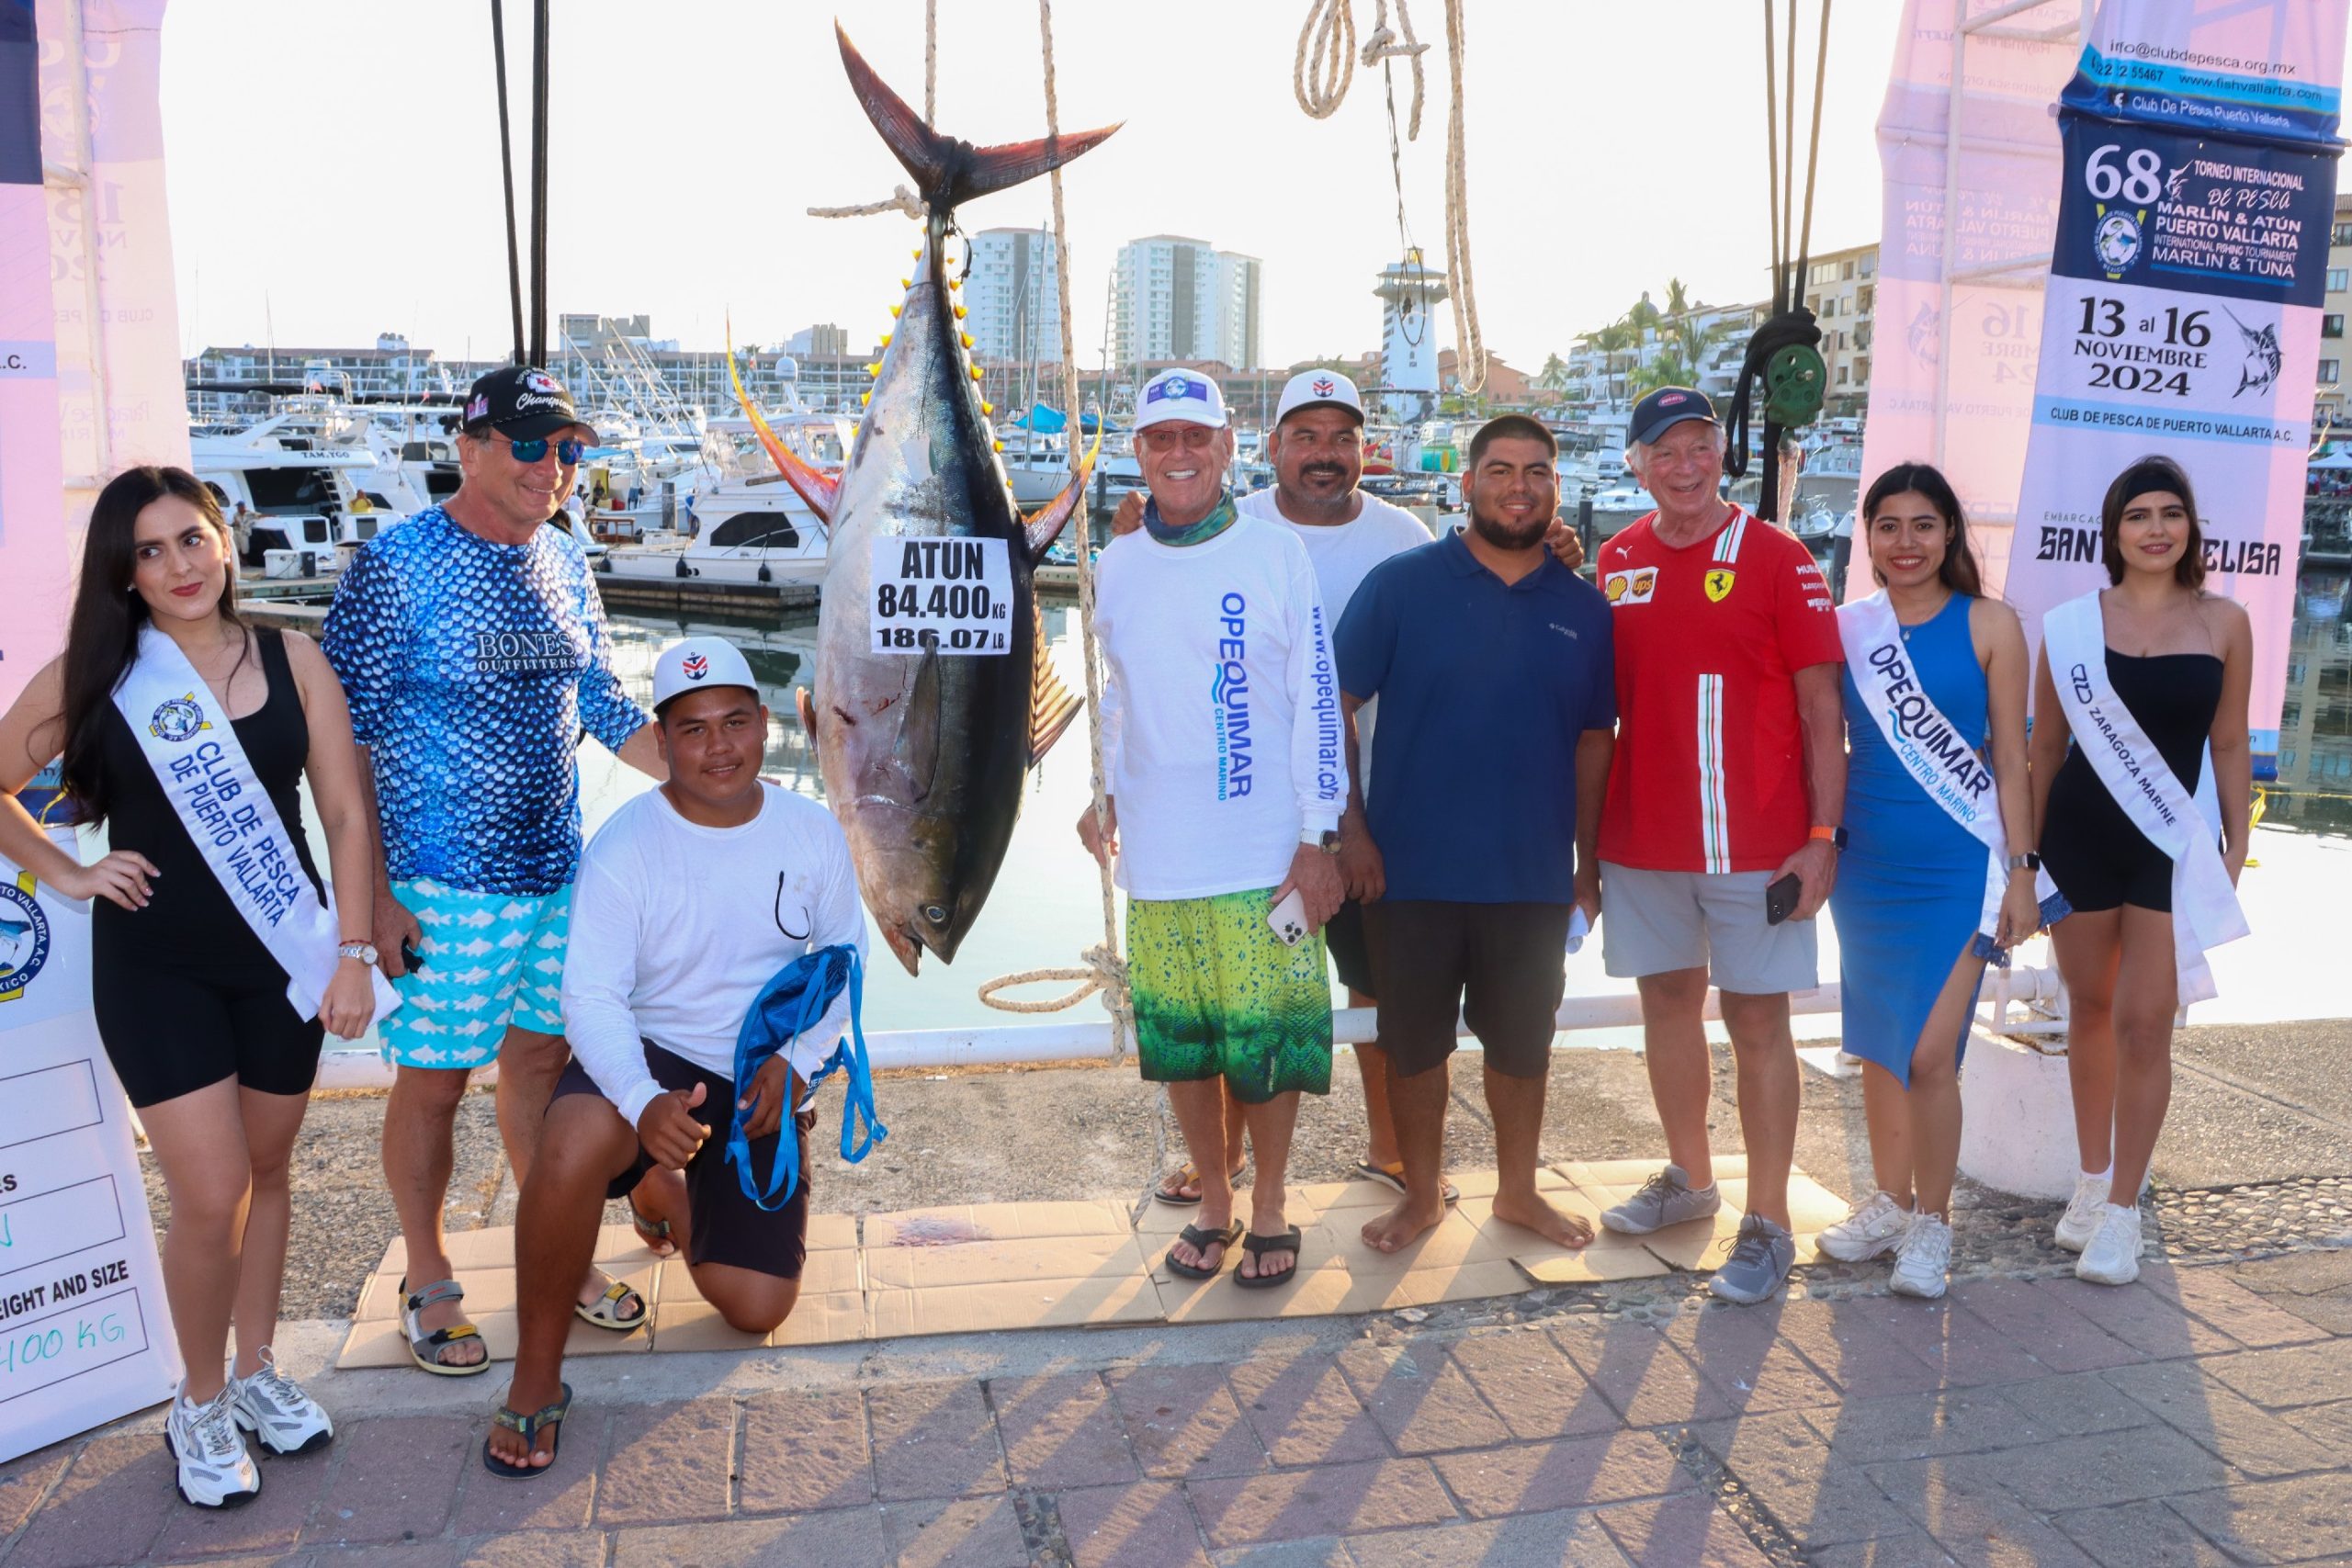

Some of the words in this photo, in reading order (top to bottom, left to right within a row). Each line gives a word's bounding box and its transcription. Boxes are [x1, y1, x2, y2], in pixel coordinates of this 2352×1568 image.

[2131, 66, 2165, 82] 55467
[2178, 72, 2323, 102] www.fishvallarta.com
[2132, 96, 2158, 113] Club
[2160, 99, 2178, 115] De
[2214, 106, 2250, 124] Puerto
[2250, 109, 2290, 129] Vallarta
[2086, 144, 2162, 205] 68
[2194, 160, 2232, 181] TORNEO
[2233, 166, 2305, 191] INTERNACIONAL
[2156, 200, 2231, 224] MARLÍN
[2234, 212, 2249, 225] &
[2252, 215, 2303, 233] ATÚN
[2207, 187, 2232, 209] DE
[2235, 189, 2291, 211] PESCA
[2154, 234, 2215, 253] INTERNATIONAL
[2215, 242, 2245, 256] FISHING
[2245, 245, 2297, 264] TOURNAMENT
[2155, 215, 2219, 239] PUERTO
[2222, 224, 2300, 250] VALLARTA
[2152, 247, 2224, 269] MARLIN
[2228, 256, 2241, 271] &
[2246, 258, 2296, 278] TUNA
[2077, 296, 2126, 338] 13
[2139, 317, 2155, 333] al
[2163, 307, 2211, 348] 16
[2074, 338, 2208, 369] NOVIEMBRE
[2087, 363, 2191, 397] 2024
[2051, 406, 2078, 422] CLUB
[2083, 411, 2099, 423] DE
[2102, 412, 2143, 429] PESCA
[2145, 416, 2160, 430] DE
[2163, 418, 2211, 434] PUERTO
[2215, 423, 2272, 441] VALLARTA
[2273, 429, 2294, 443] A.C.
[2044, 511, 2104, 526] EMBARCAC
[2036, 525, 2104, 564] SAN
[2203, 538, 2281, 576] ELISA
[877, 583, 990, 620] 84.400
[992, 604, 1006, 620] KG
[1634, 580, 1653, 595] ups
[475, 633, 575, 659] BONES
[876, 627, 989, 649] 186.07
[992, 633, 1005, 649] LB
[478, 658, 576, 671] OUTFITTERS
[1218, 592, 1252, 799] OPEQUIMAR
[1214, 708, 1227, 754] CENTRO
[1869, 644, 1991, 800] OPEQUIMAR
[169, 754, 200, 784] DE
[1217, 756, 1227, 802] MARINO
[1900, 743, 1939, 785] CENTRO
[1936, 784, 1976, 823] MARINO
[2089, 706, 2141, 779] ZARAGOZA
[2138, 777, 2177, 828] MARINE
[184, 781, 238, 848] PUERTO
[196, 741, 242, 802] CLUB
[232, 803, 263, 838] DE
[254, 836, 301, 908] PESCA
[226, 844, 288, 929] VALLARTA
[0, 1286, 45, 1321] EIGHT
[53, 1274, 87, 1303] AND
[91, 1259, 129, 1289] SIZE
[78, 1313, 124, 1349] KG
